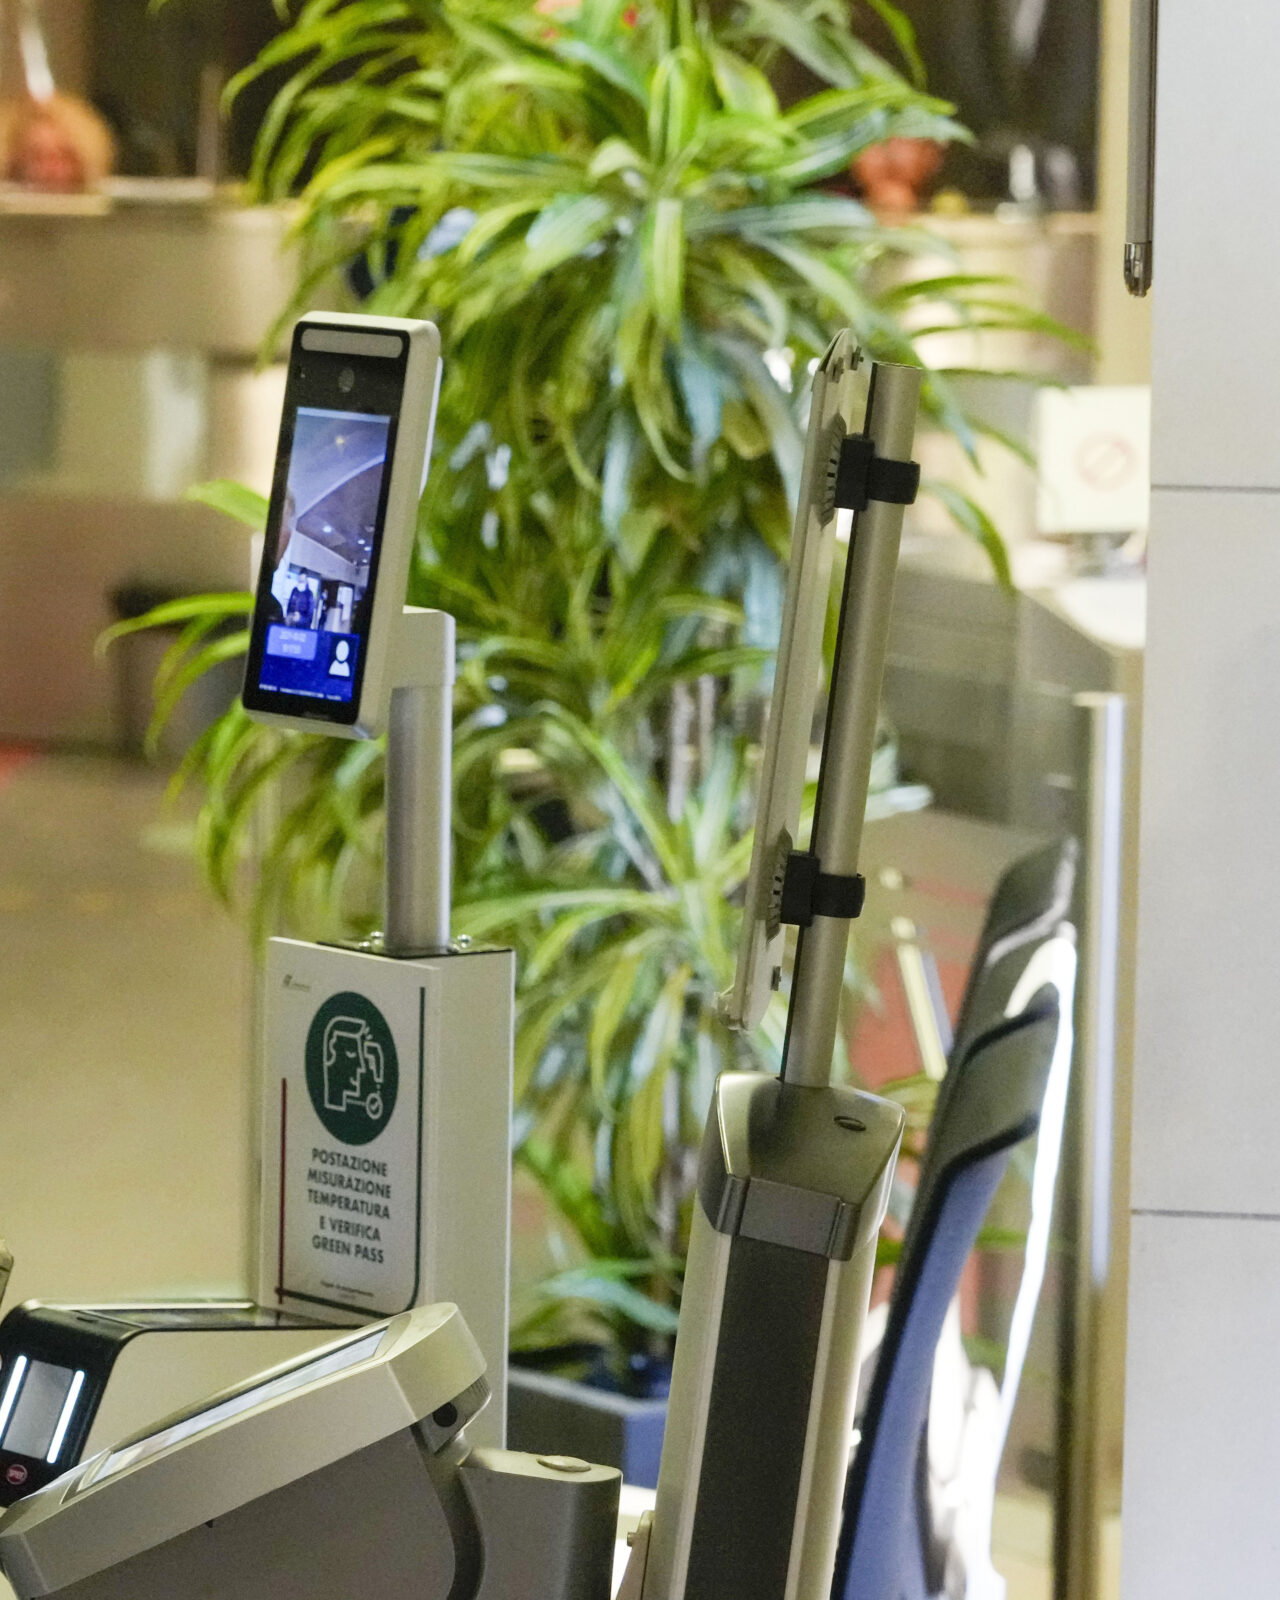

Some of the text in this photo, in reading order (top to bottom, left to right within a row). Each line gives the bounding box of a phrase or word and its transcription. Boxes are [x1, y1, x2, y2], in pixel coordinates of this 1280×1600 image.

[311, 1148, 388, 1177] POSTAZIONE
[307, 1168, 392, 1199] MISURAZIONE
[307, 1188, 391, 1220] TEMPERATURA
[319, 1215, 382, 1242] E VERIFICA
[311, 1234, 385, 1264] GREEN PASS
